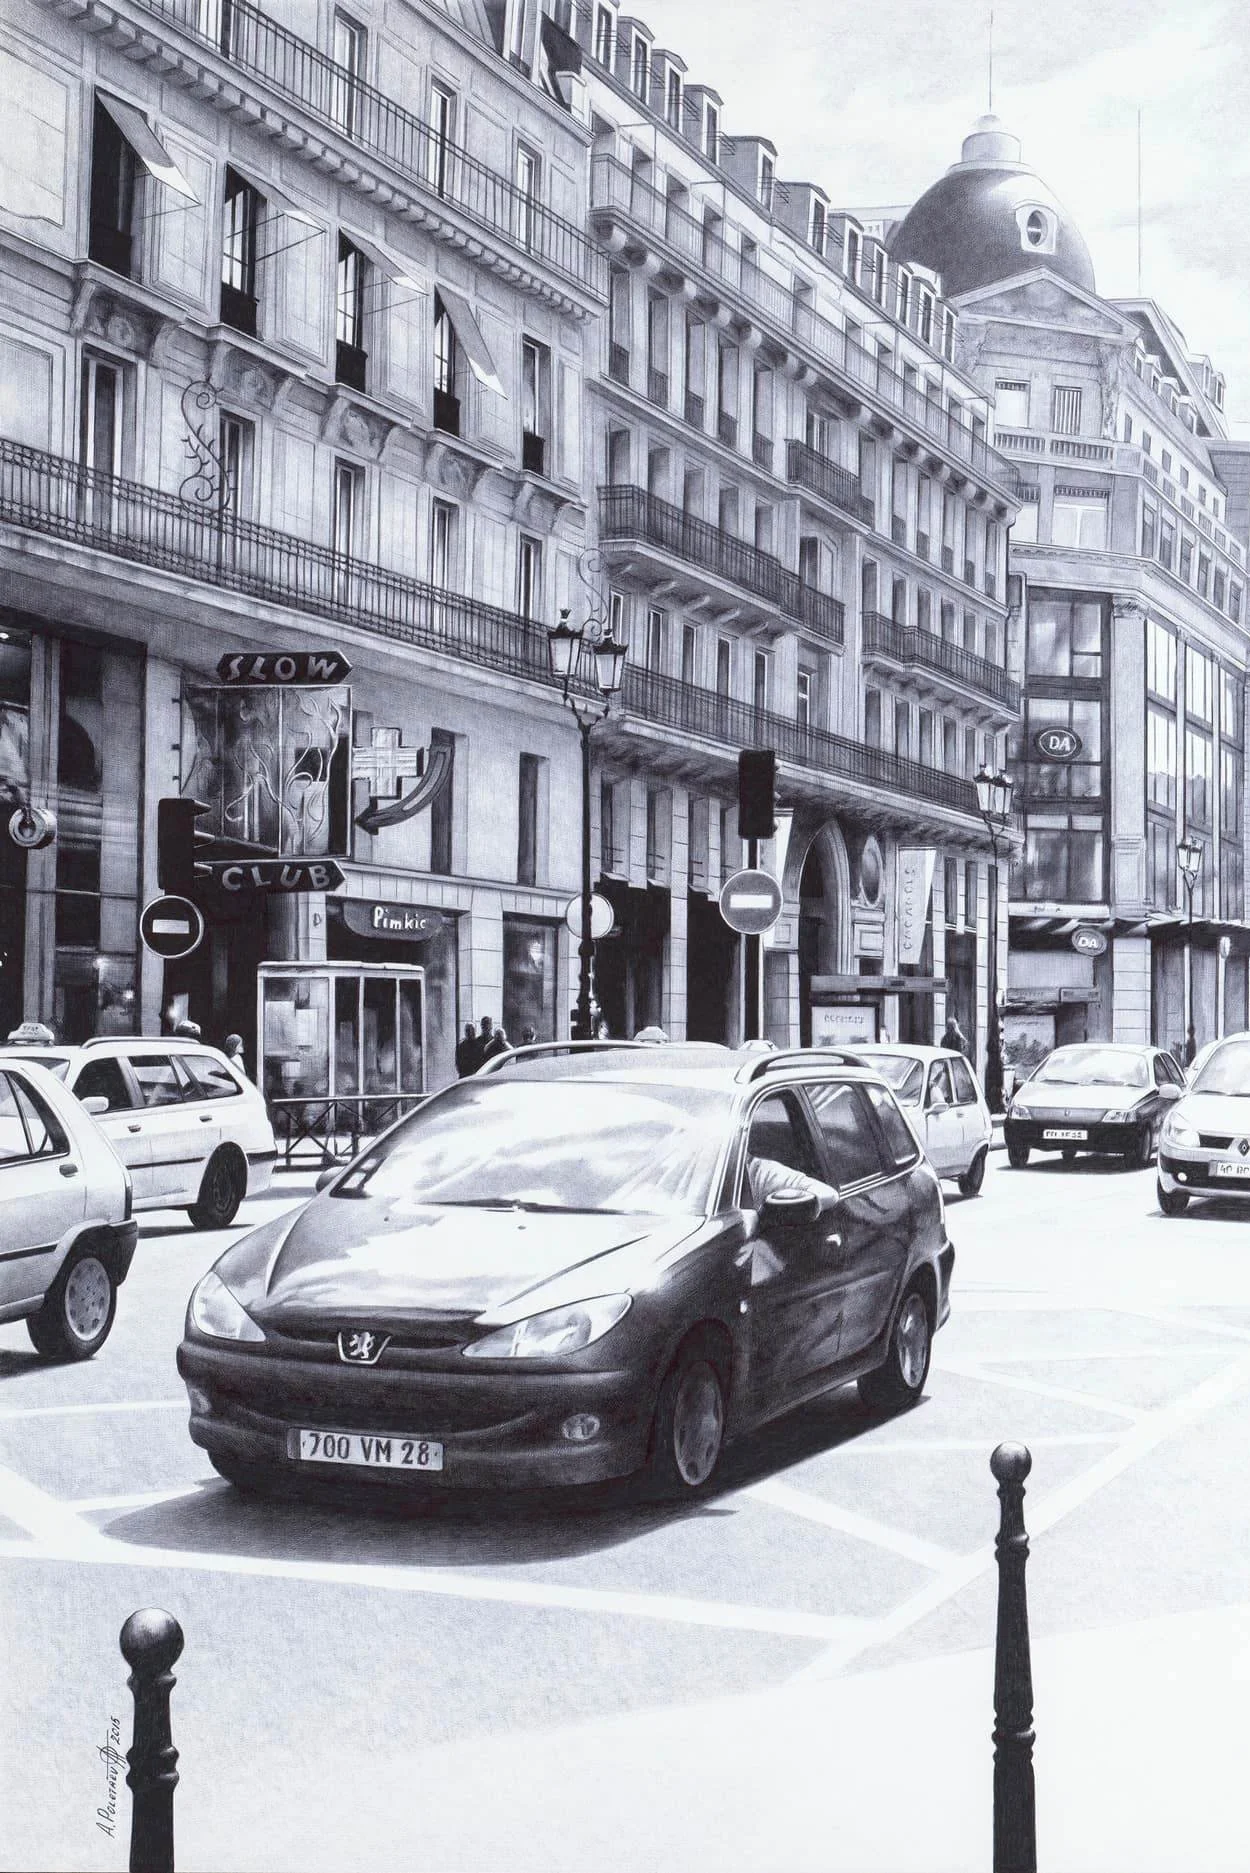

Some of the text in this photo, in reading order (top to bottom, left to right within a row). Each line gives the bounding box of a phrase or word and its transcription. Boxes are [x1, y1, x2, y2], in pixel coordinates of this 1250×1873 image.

[227, 655, 338, 681] SLOW
[1049, 735, 1071, 752] DA
[222, 864, 331, 891] CLUB
[1077, 936, 1098, 949] DA
[309, 1432, 431, 1466] 700 VM 28
[110, 1716, 120, 1746] 2015
